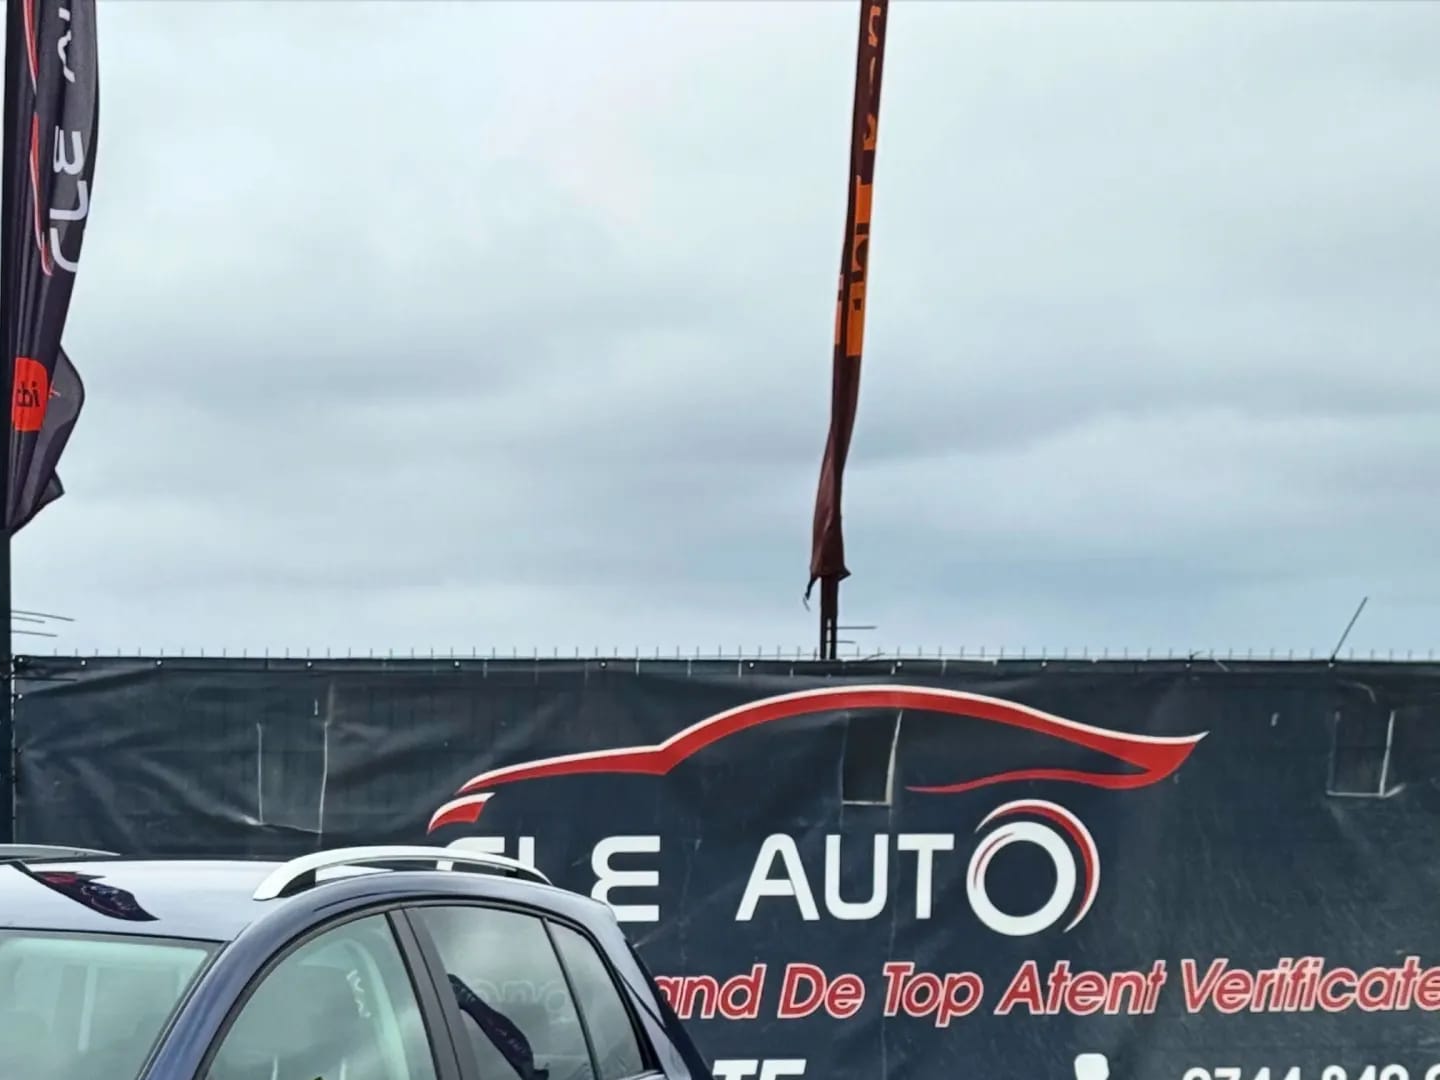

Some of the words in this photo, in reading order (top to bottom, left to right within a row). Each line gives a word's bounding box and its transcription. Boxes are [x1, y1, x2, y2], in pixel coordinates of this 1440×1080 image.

[735, 820, 1077, 936] AUTO
[653, 963, 767, 1020] and
[777, 963, 865, 1020] De
[883, 962, 983, 1028] Top
[994, 960, 1166, 1015] Atent
